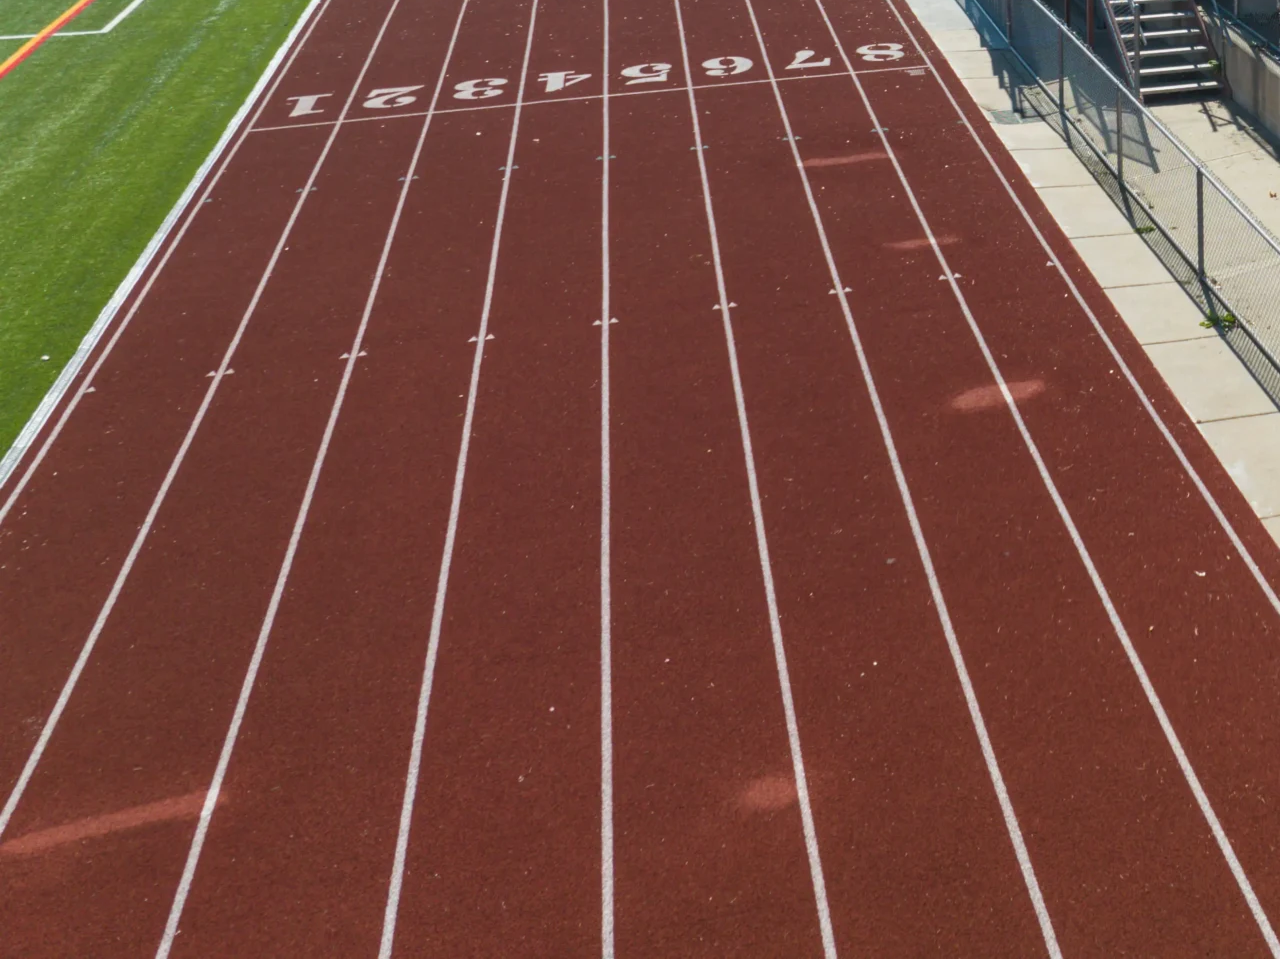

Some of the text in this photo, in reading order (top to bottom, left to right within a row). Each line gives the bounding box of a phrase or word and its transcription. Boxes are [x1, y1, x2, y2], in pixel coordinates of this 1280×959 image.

[784, 49, 831, 69] 7
[856, 43, 904, 61] 8
[621, 63, 672, 85] 5
[701, 56, 753, 76] 6
[453, 78, 508, 99] 3
[538, 71, 591, 92] 4
[287, 93, 333, 117] 1
[362, 84, 425, 108] 2
